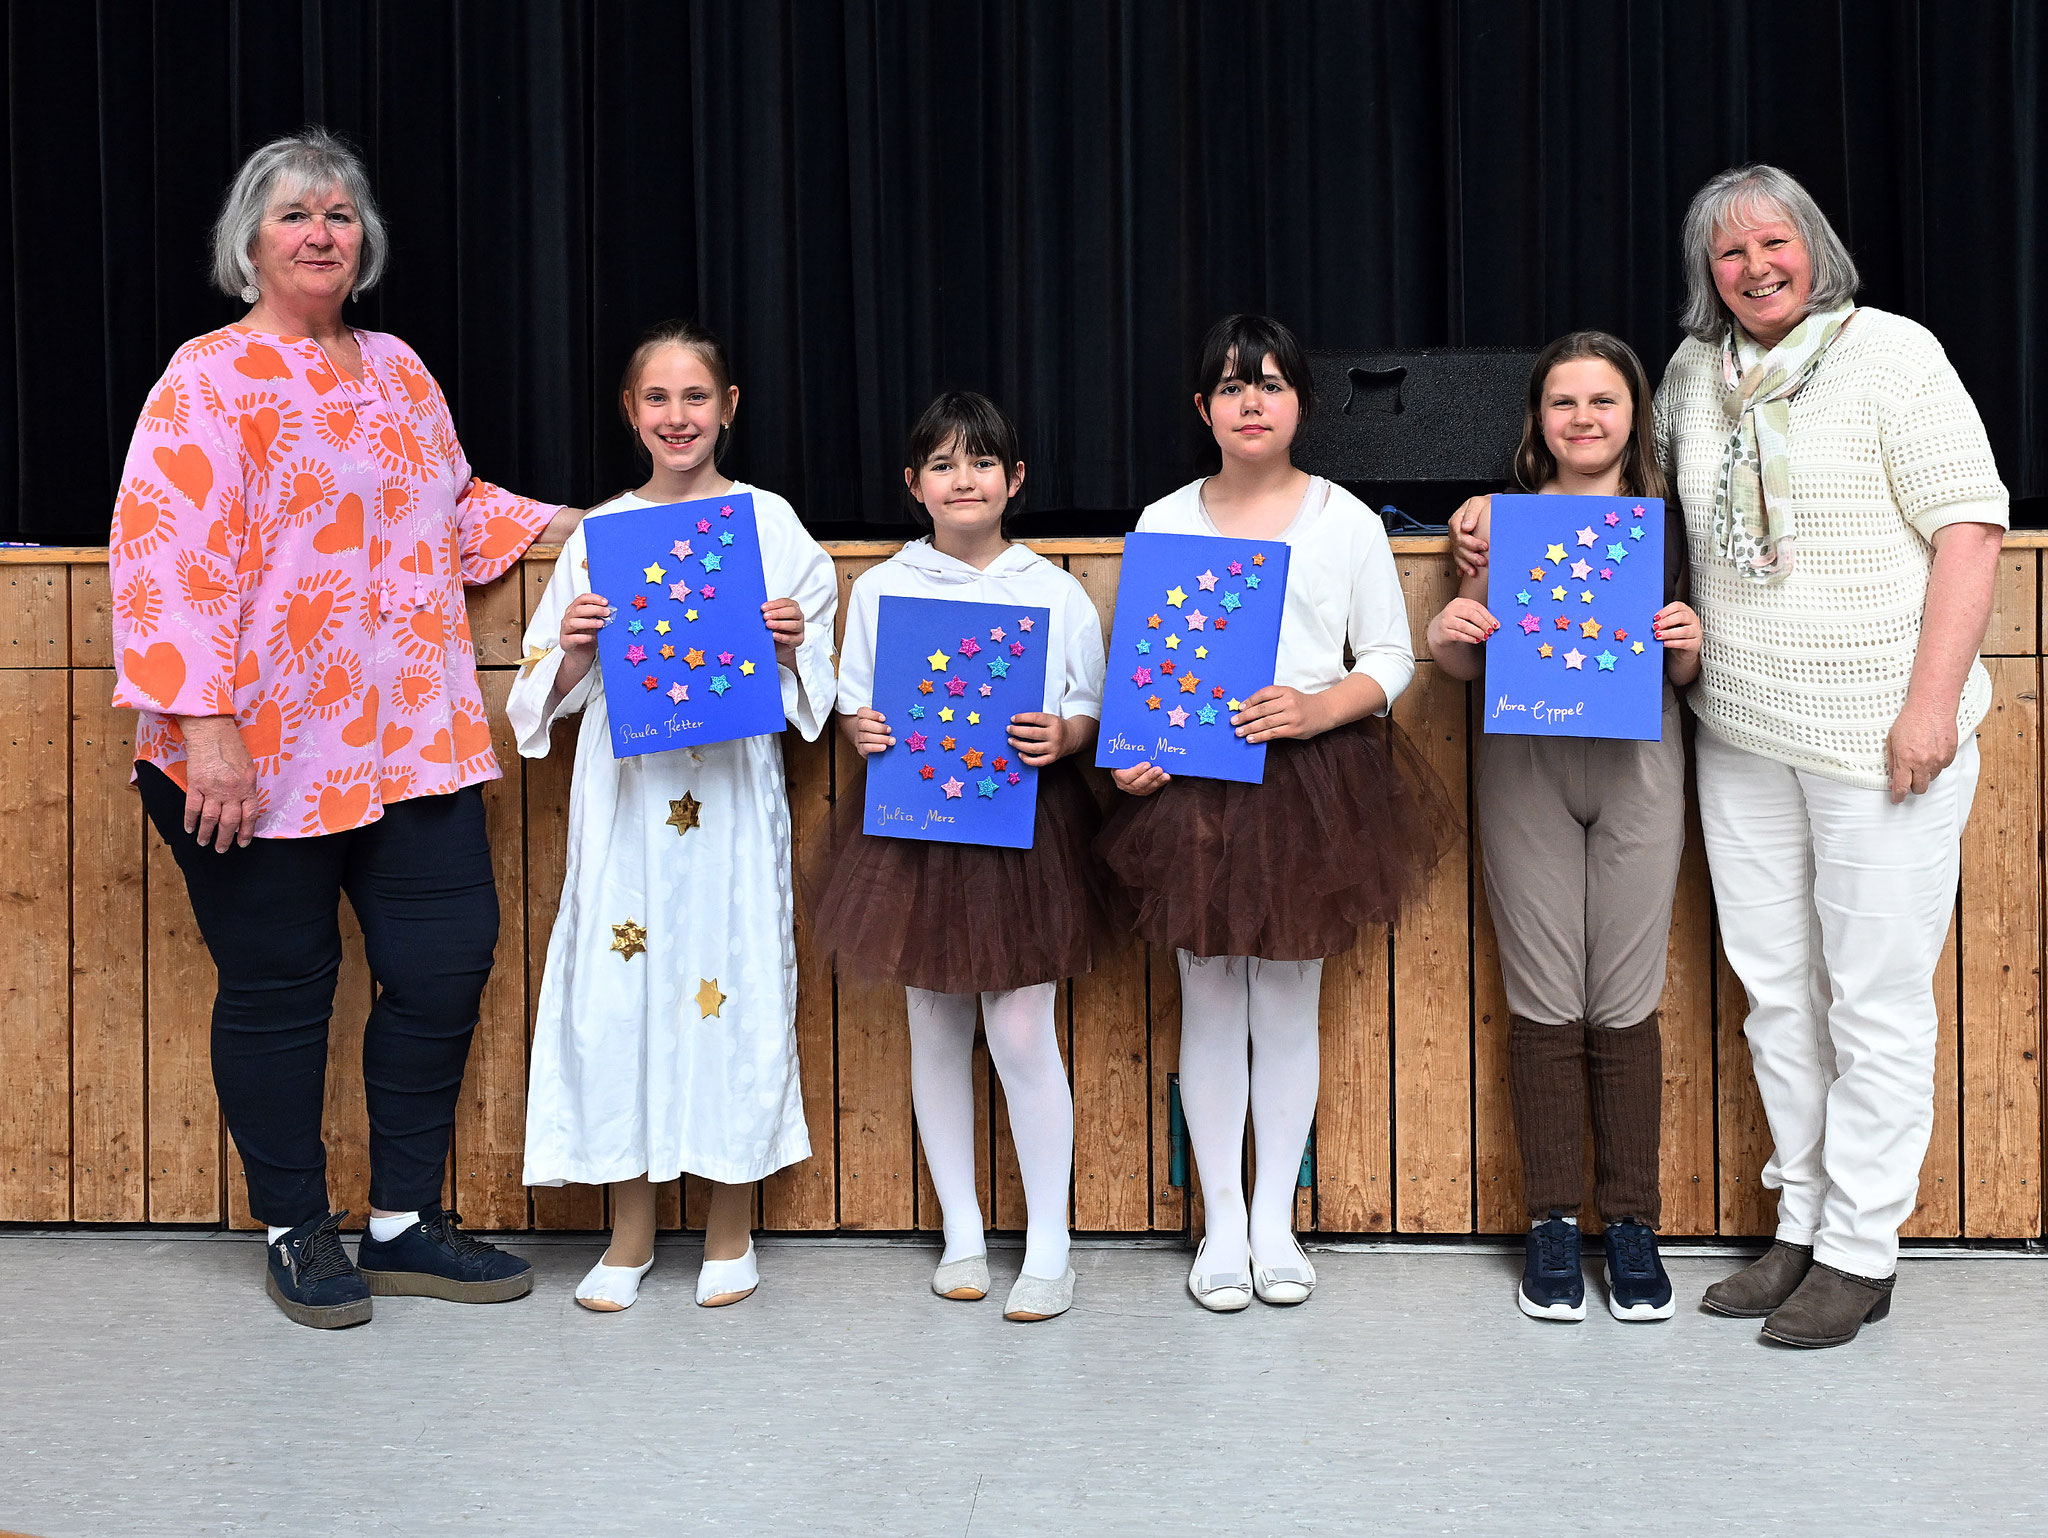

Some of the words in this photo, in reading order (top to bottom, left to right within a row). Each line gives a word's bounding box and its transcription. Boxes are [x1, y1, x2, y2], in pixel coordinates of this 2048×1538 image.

[1492, 694, 1527, 718] Nora
[619, 723, 659, 744] Paula
[664, 713, 704, 738] Ketter
[1108, 732, 1146, 754] Klara
[1150, 737, 1187, 760] Merz
[877, 804, 914, 826] Julia
[920, 809, 956, 831] Merz
